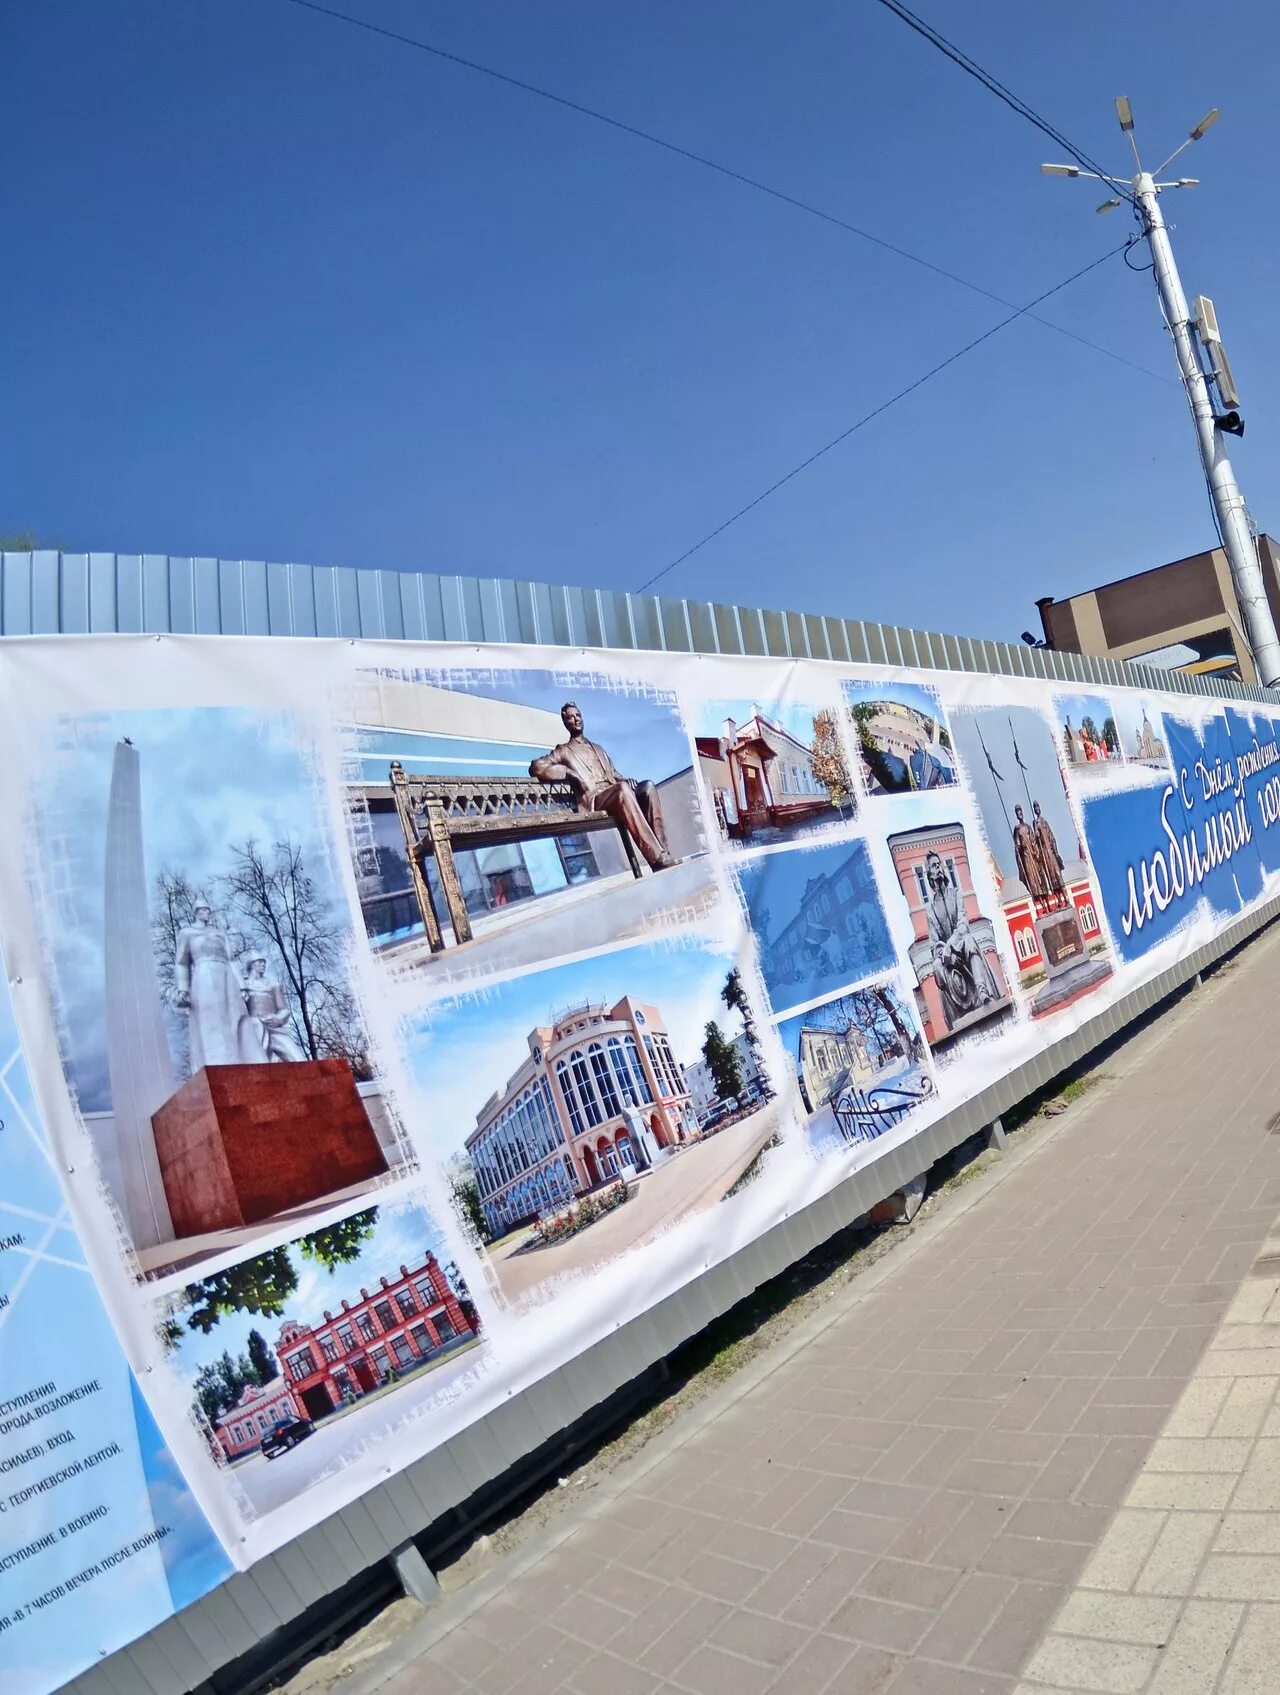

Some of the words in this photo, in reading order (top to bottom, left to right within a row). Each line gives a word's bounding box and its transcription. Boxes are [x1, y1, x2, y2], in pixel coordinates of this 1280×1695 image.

[47, 1429, 76, 1450] ВХОД
[9, 1460, 84, 1507] ГЕОРГИЕВСКОЙ
[59, 1527, 69, 1538] В
[24, 1604, 32, 1615] 7
[32, 1585, 66, 1609] ЧАСОВ
[65, 1565, 102, 1592] ВЕЧЕРА
[101, 1547, 133, 1571] ПОСЛЕ
